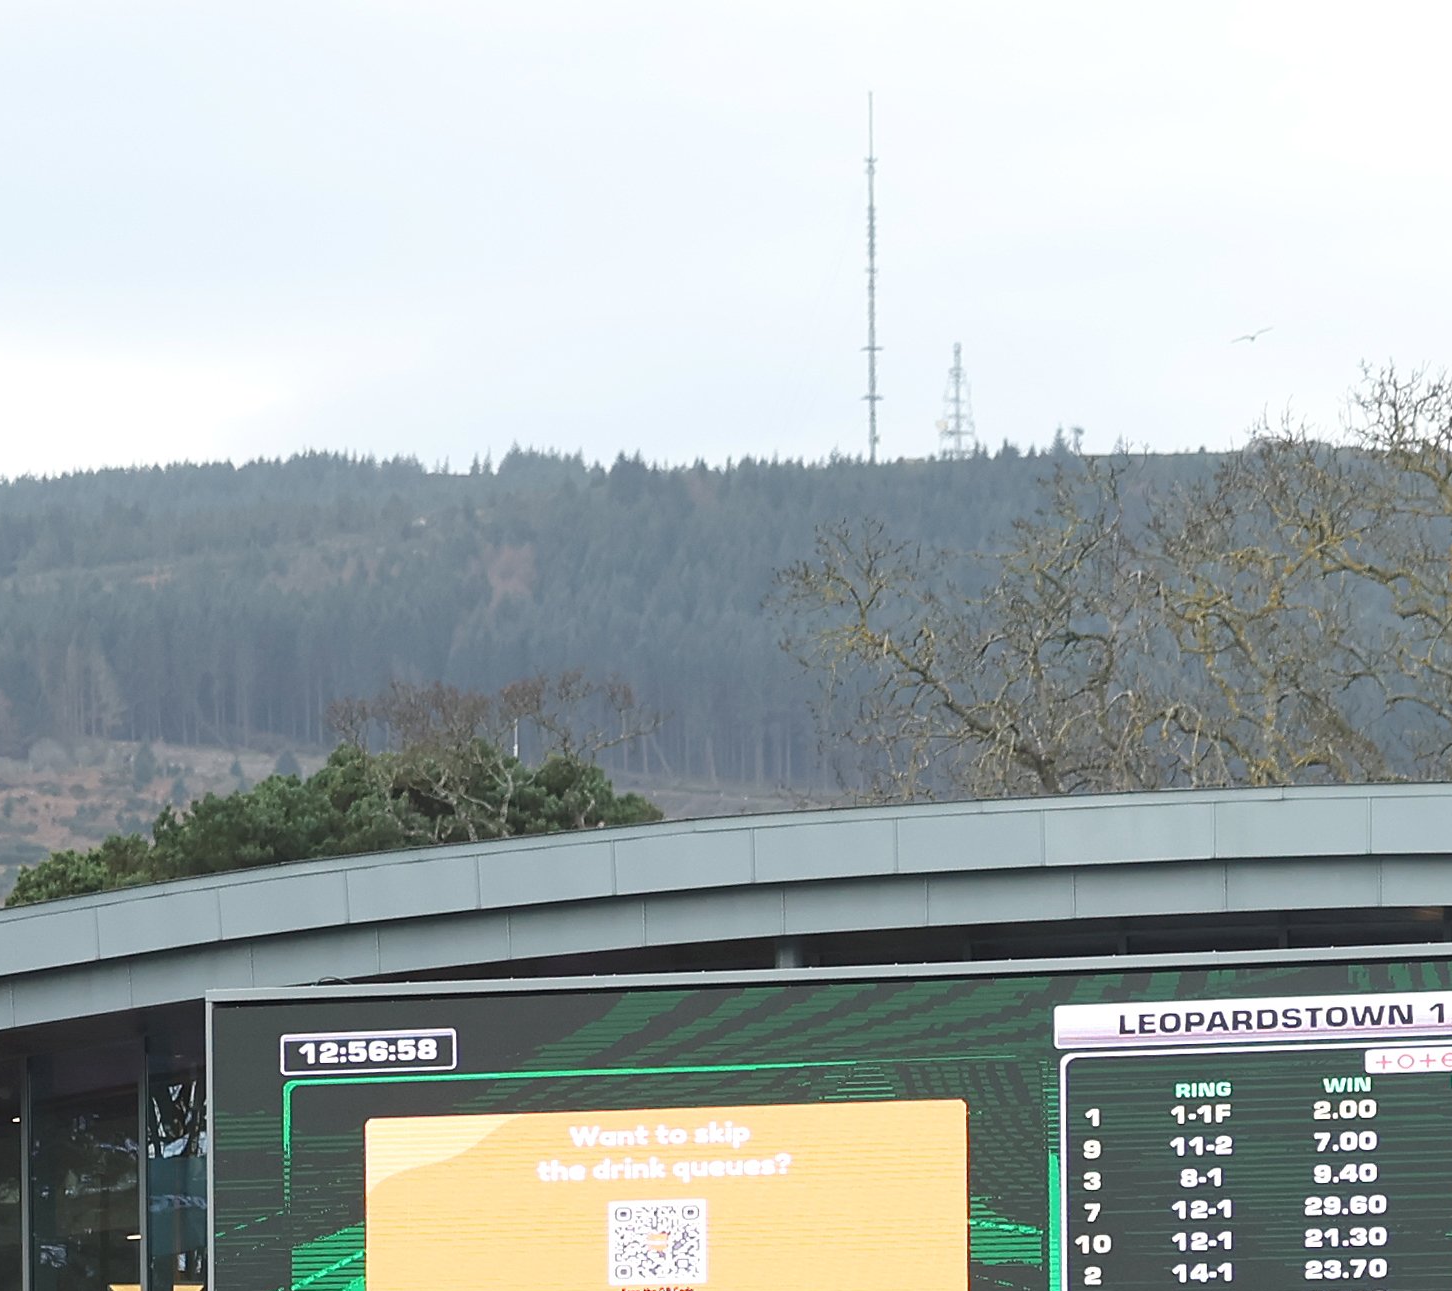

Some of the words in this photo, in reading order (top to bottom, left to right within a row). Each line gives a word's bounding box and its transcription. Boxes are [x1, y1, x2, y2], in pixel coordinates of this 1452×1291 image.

[1119, 1003, 1414, 1035] LEOPARDSTOWN
[299, 1039, 438, 1065] 12:56:58
[1175, 1081, 1232, 1098] RING
[1323, 1076, 1372, 1093] WIN
[1085, 1108, 1100, 1127] 1
[1171, 1103, 1231, 1125] 1-1F
[1314, 1099, 1377, 1120] 2.00
[569, 1125, 652, 1148] Want
[655, 1126, 687, 1145] to
[695, 1121, 751, 1148] skip
[1084, 1139, 1101, 1160] 9
[1170, 1135, 1233, 1157] 11-2
[1314, 1130, 1378, 1152] 7.00
[537, 1159, 588, 1181] the
[593, 1157, 665, 1180] drink
[673, 1153, 792, 1183] queues?
[1084, 1171, 1102, 1191] 3
[1181, 1167, 1222, 1188] 8-1
[1314, 1163, 1378, 1184] 9.40
[1084, 1202, 1101, 1223] 7
[1172, 1199, 1232, 1220] 12-1
[1305, 1194, 1387, 1216] 29.60
[1074, 1234, 1112, 1254] 10
[1172, 1230, 1232, 1252] 12-1
[1305, 1226, 1388, 1248] 21.30
[1084, 1266, 1102, 1286] 2
[1172, 1262, 1233, 1283] 14-1
[1305, 1258, 1388, 1280] 23.70
